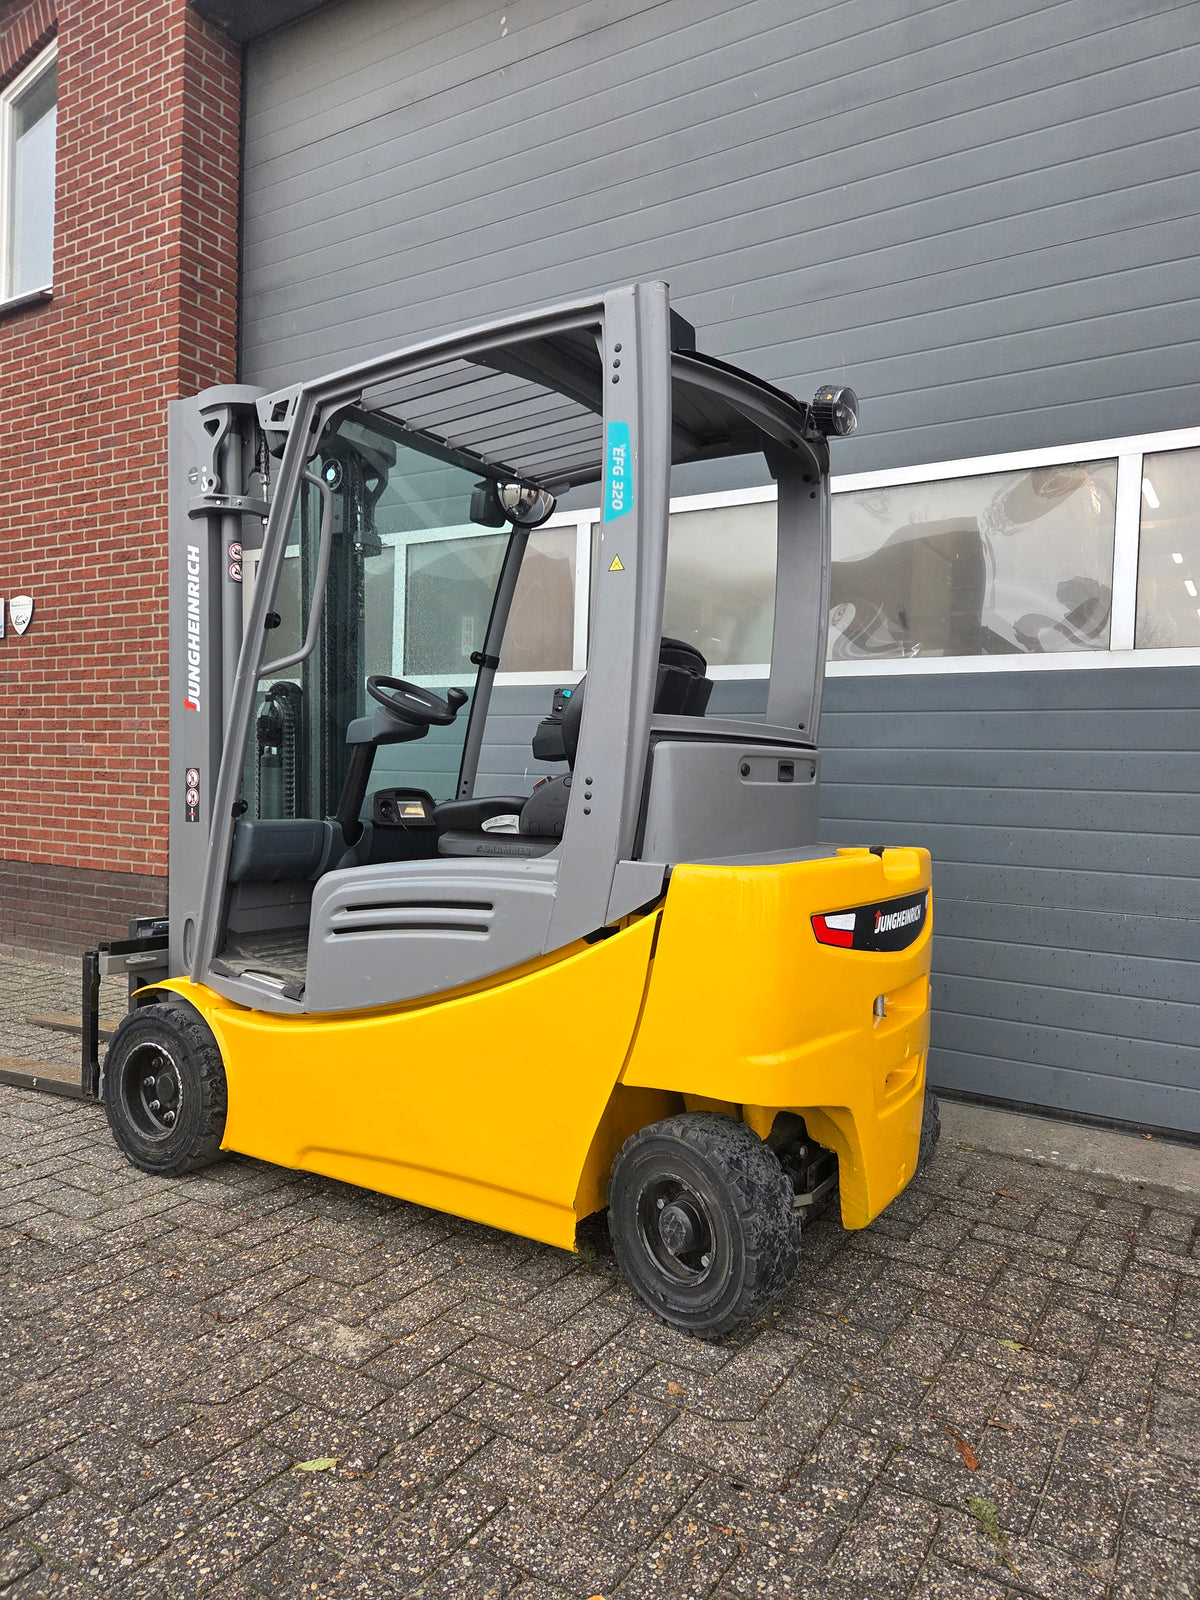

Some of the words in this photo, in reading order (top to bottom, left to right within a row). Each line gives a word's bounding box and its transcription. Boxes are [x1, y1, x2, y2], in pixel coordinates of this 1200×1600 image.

[612, 447, 625, 476] EFG
[611, 480, 624, 511] 320
[186, 545, 201, 713] JUNGHEINRICH
[874, 904, 922, 934] JUNGHEINRICH
